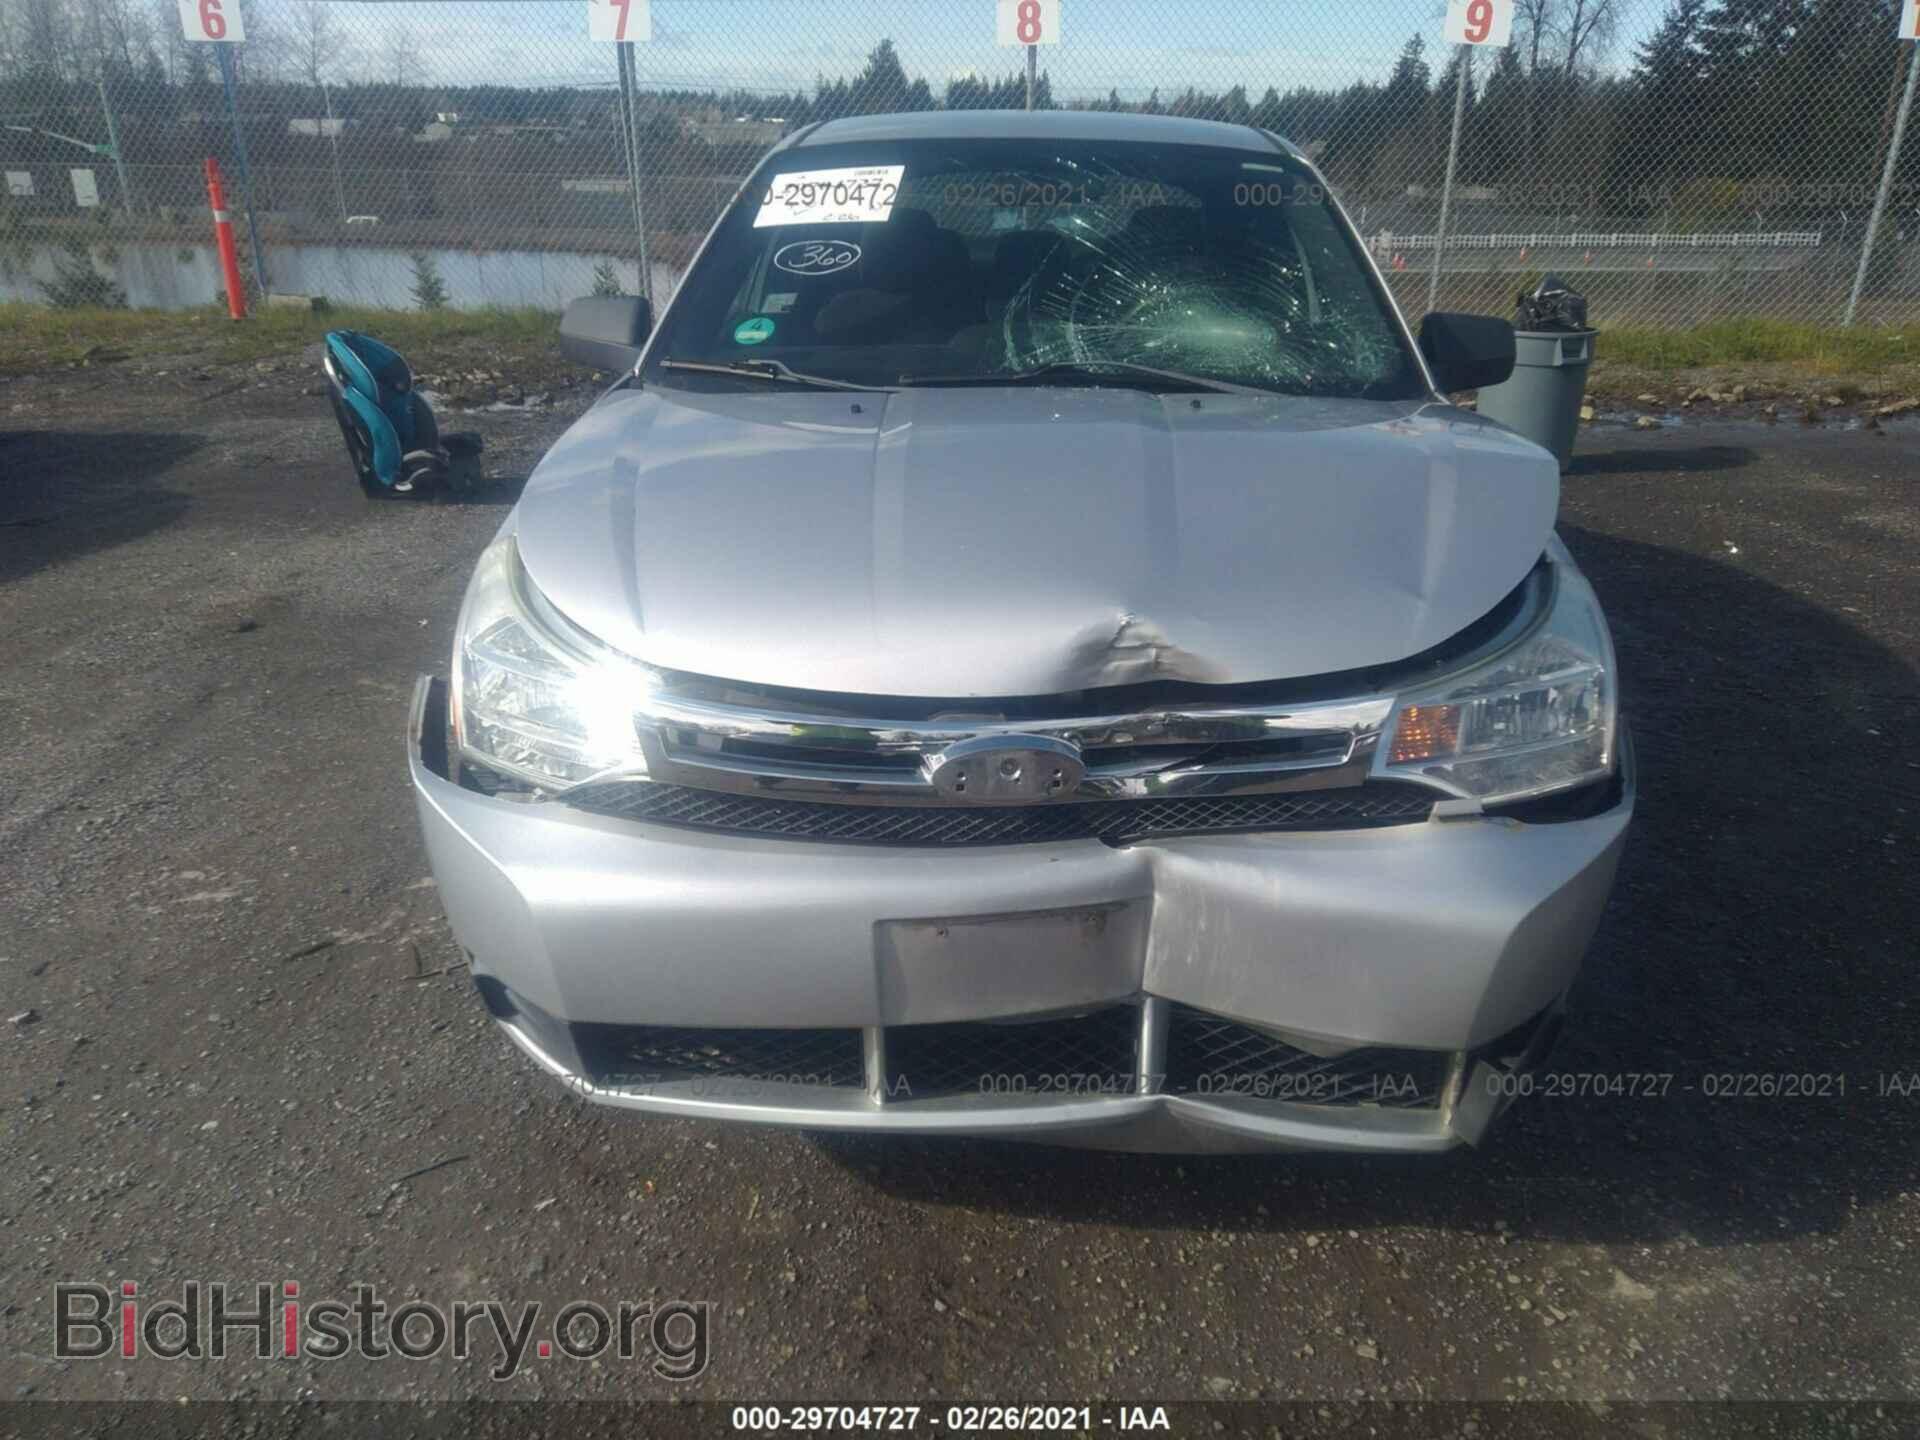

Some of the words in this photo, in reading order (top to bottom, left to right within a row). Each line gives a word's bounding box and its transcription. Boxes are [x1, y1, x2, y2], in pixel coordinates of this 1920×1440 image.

[199, 0, 226, 39] 6
[610, 0, 629, 40] 7
[1017, 0, 1042, 43] 8
[1465, 0, 1493, 43] 9
[788, 244, 852, 268] 360
